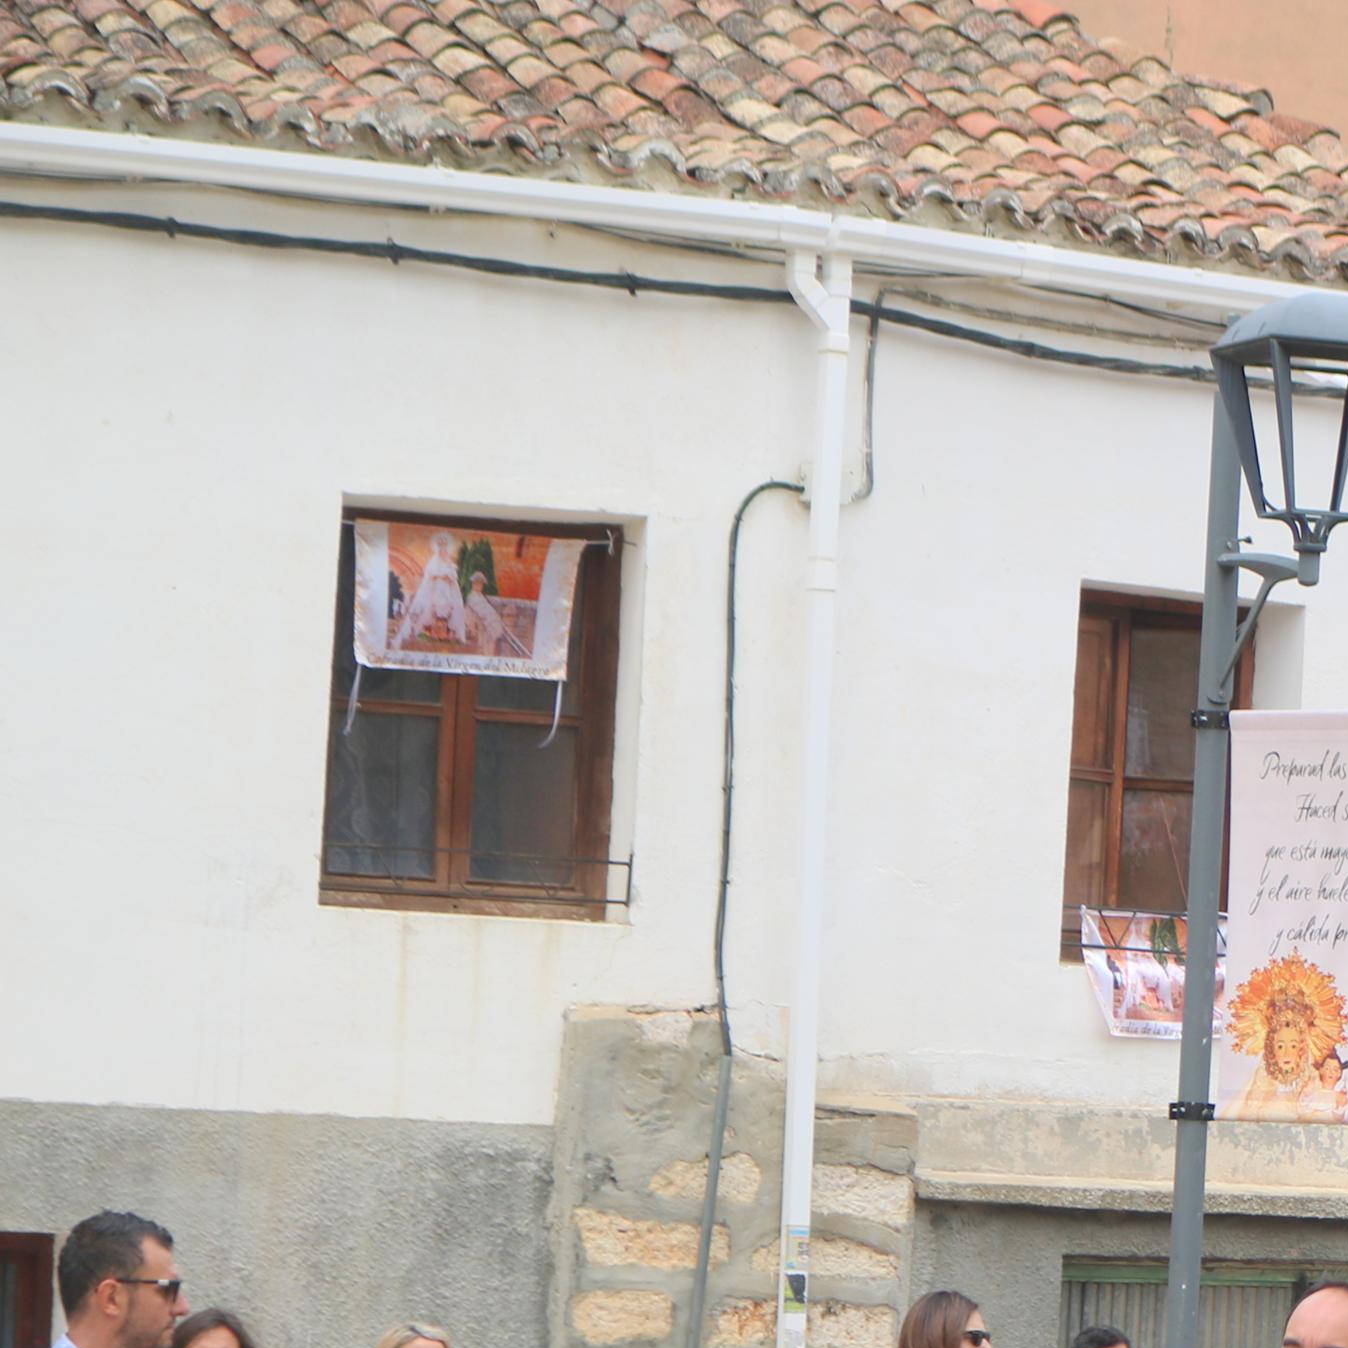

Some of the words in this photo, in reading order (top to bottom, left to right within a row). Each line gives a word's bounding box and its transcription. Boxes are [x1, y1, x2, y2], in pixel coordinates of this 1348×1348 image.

[1259, 750, 1330, 784] Preparad
[1329, 754, 1347, 780] las
[1295, 790, 1344, 822] Haced
[1260, 845, 1286, 885] que
[1249, 884, 1264, 915] y
[1267, 874, 1289, 901] el
[1285, 881, 1312, 901] aire
[1270, 930, 1284, 955] y
[1286, 914, 1331, 942] cálida
